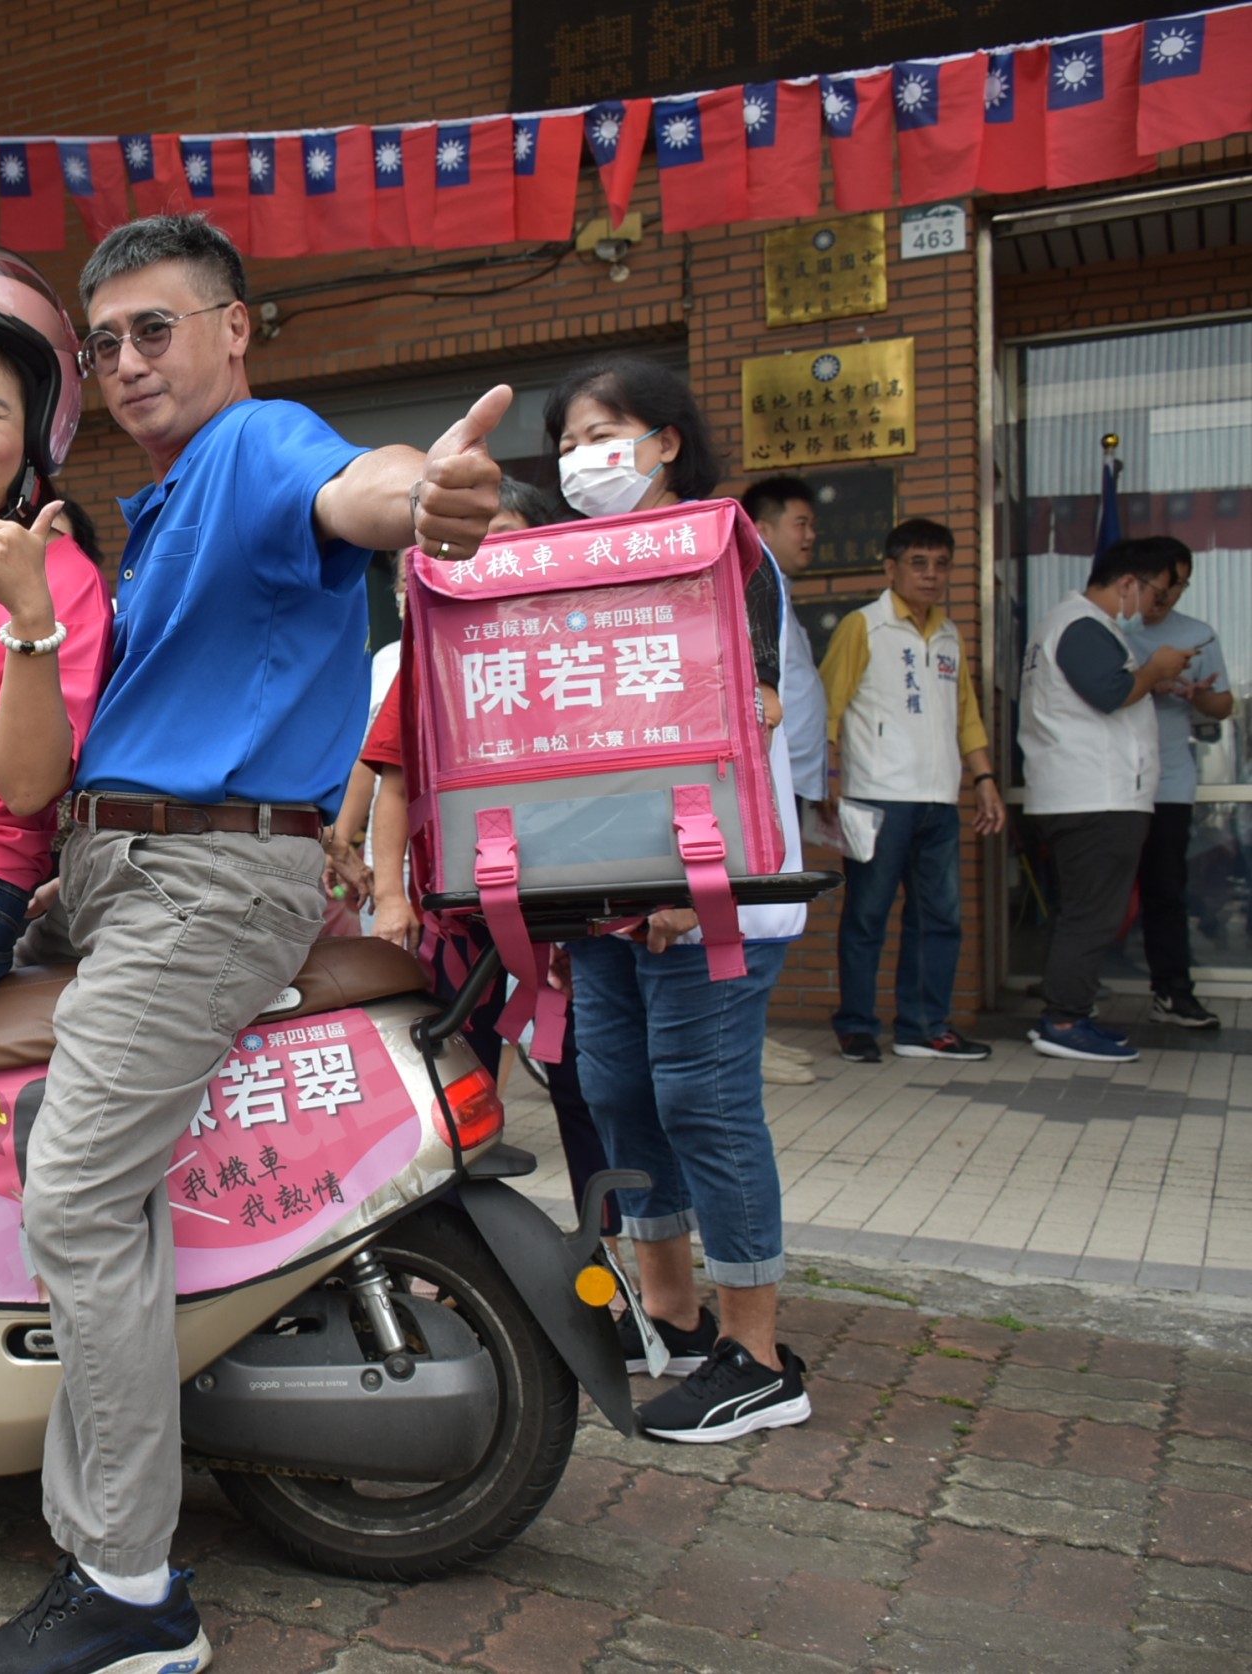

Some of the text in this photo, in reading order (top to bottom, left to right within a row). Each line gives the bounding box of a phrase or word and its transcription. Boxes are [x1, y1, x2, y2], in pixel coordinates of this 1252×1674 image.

[913, 229, 954, 250] 463
[463, 605, 674, 642] 立委候選人 第四選區
[462, 634, 685, 719] 陳若翠
[478, 725, 680, 758] 仁武 鳥松 大寮 林園
[267, 1022, 347, 1048] 第四選區
[182, 1145, 287, 1201] 我機車
[240, 1170, 345, 1227] 我熱情
